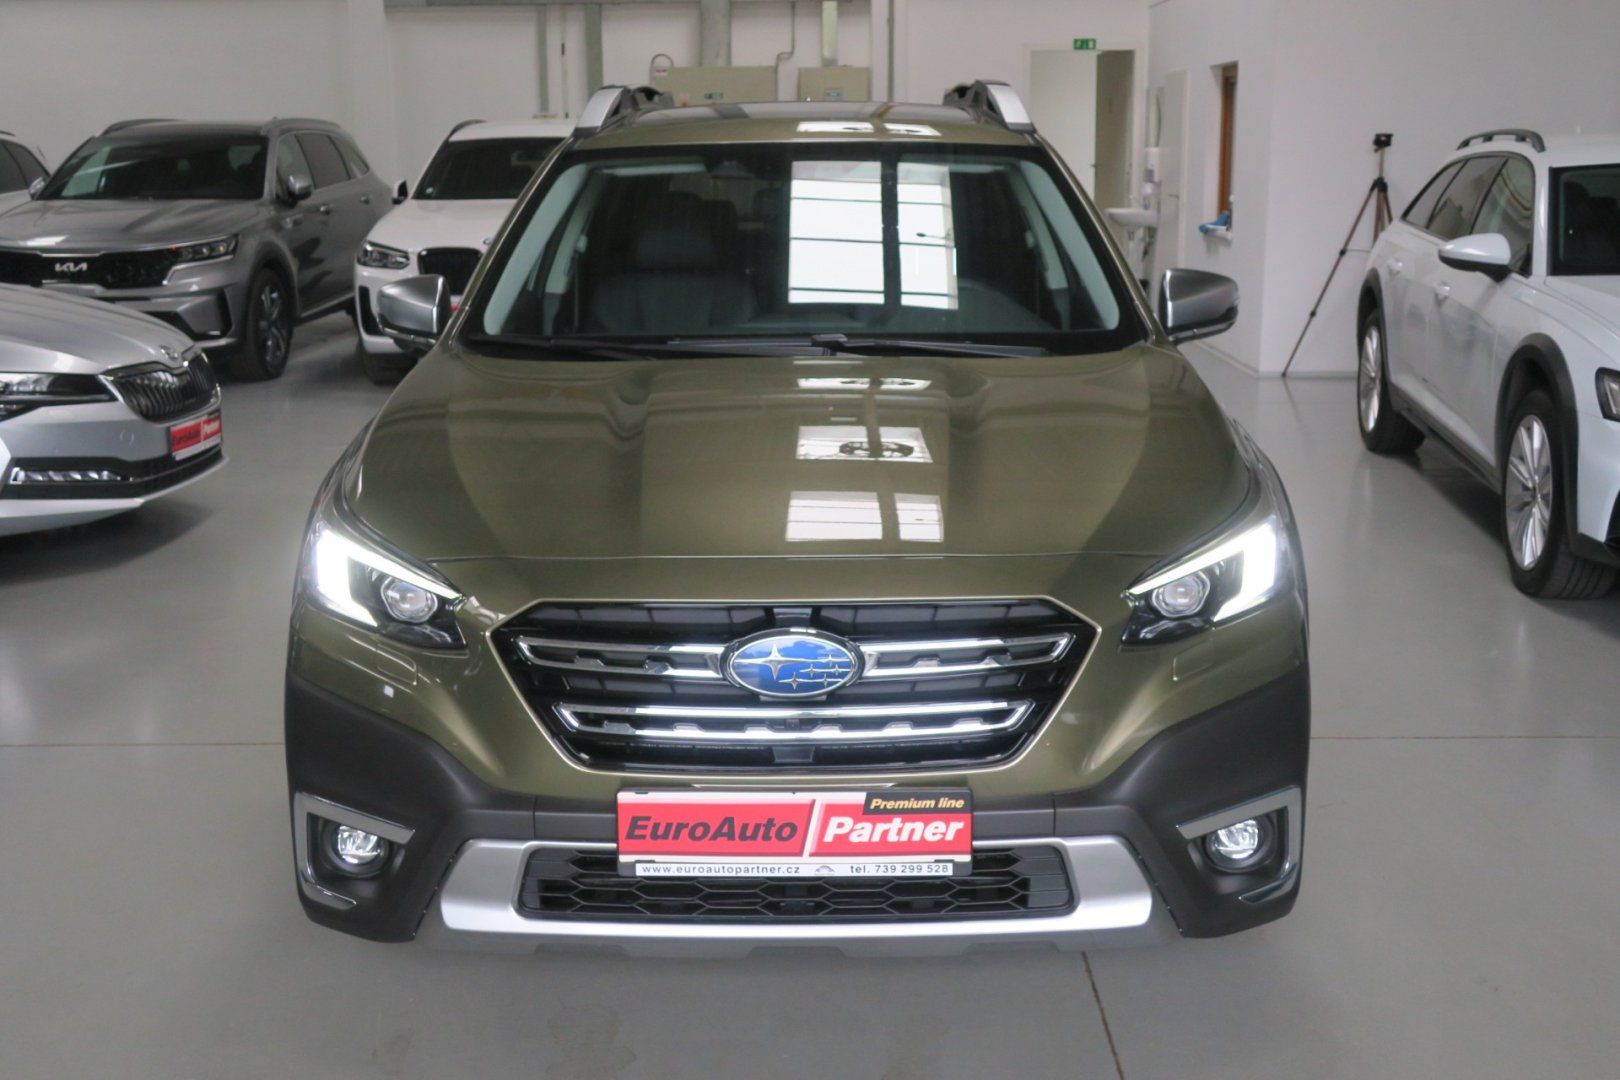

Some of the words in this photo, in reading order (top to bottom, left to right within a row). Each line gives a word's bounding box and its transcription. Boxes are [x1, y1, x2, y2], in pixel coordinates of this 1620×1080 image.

[870, 798, 935, 810] Premium
[938, 798, 965, 809] line
[625, 816, 797, 842] EuroAuto
[823, 816, 964, 842] Partner
[642, 866, 800, 876] www.euroautopartner.cz
[850, 866, 870, 874] tel.
[875, 865, 897, 874] 739
[901, 865, 923, 874] 299
[927, 865, 949, 874] 528
